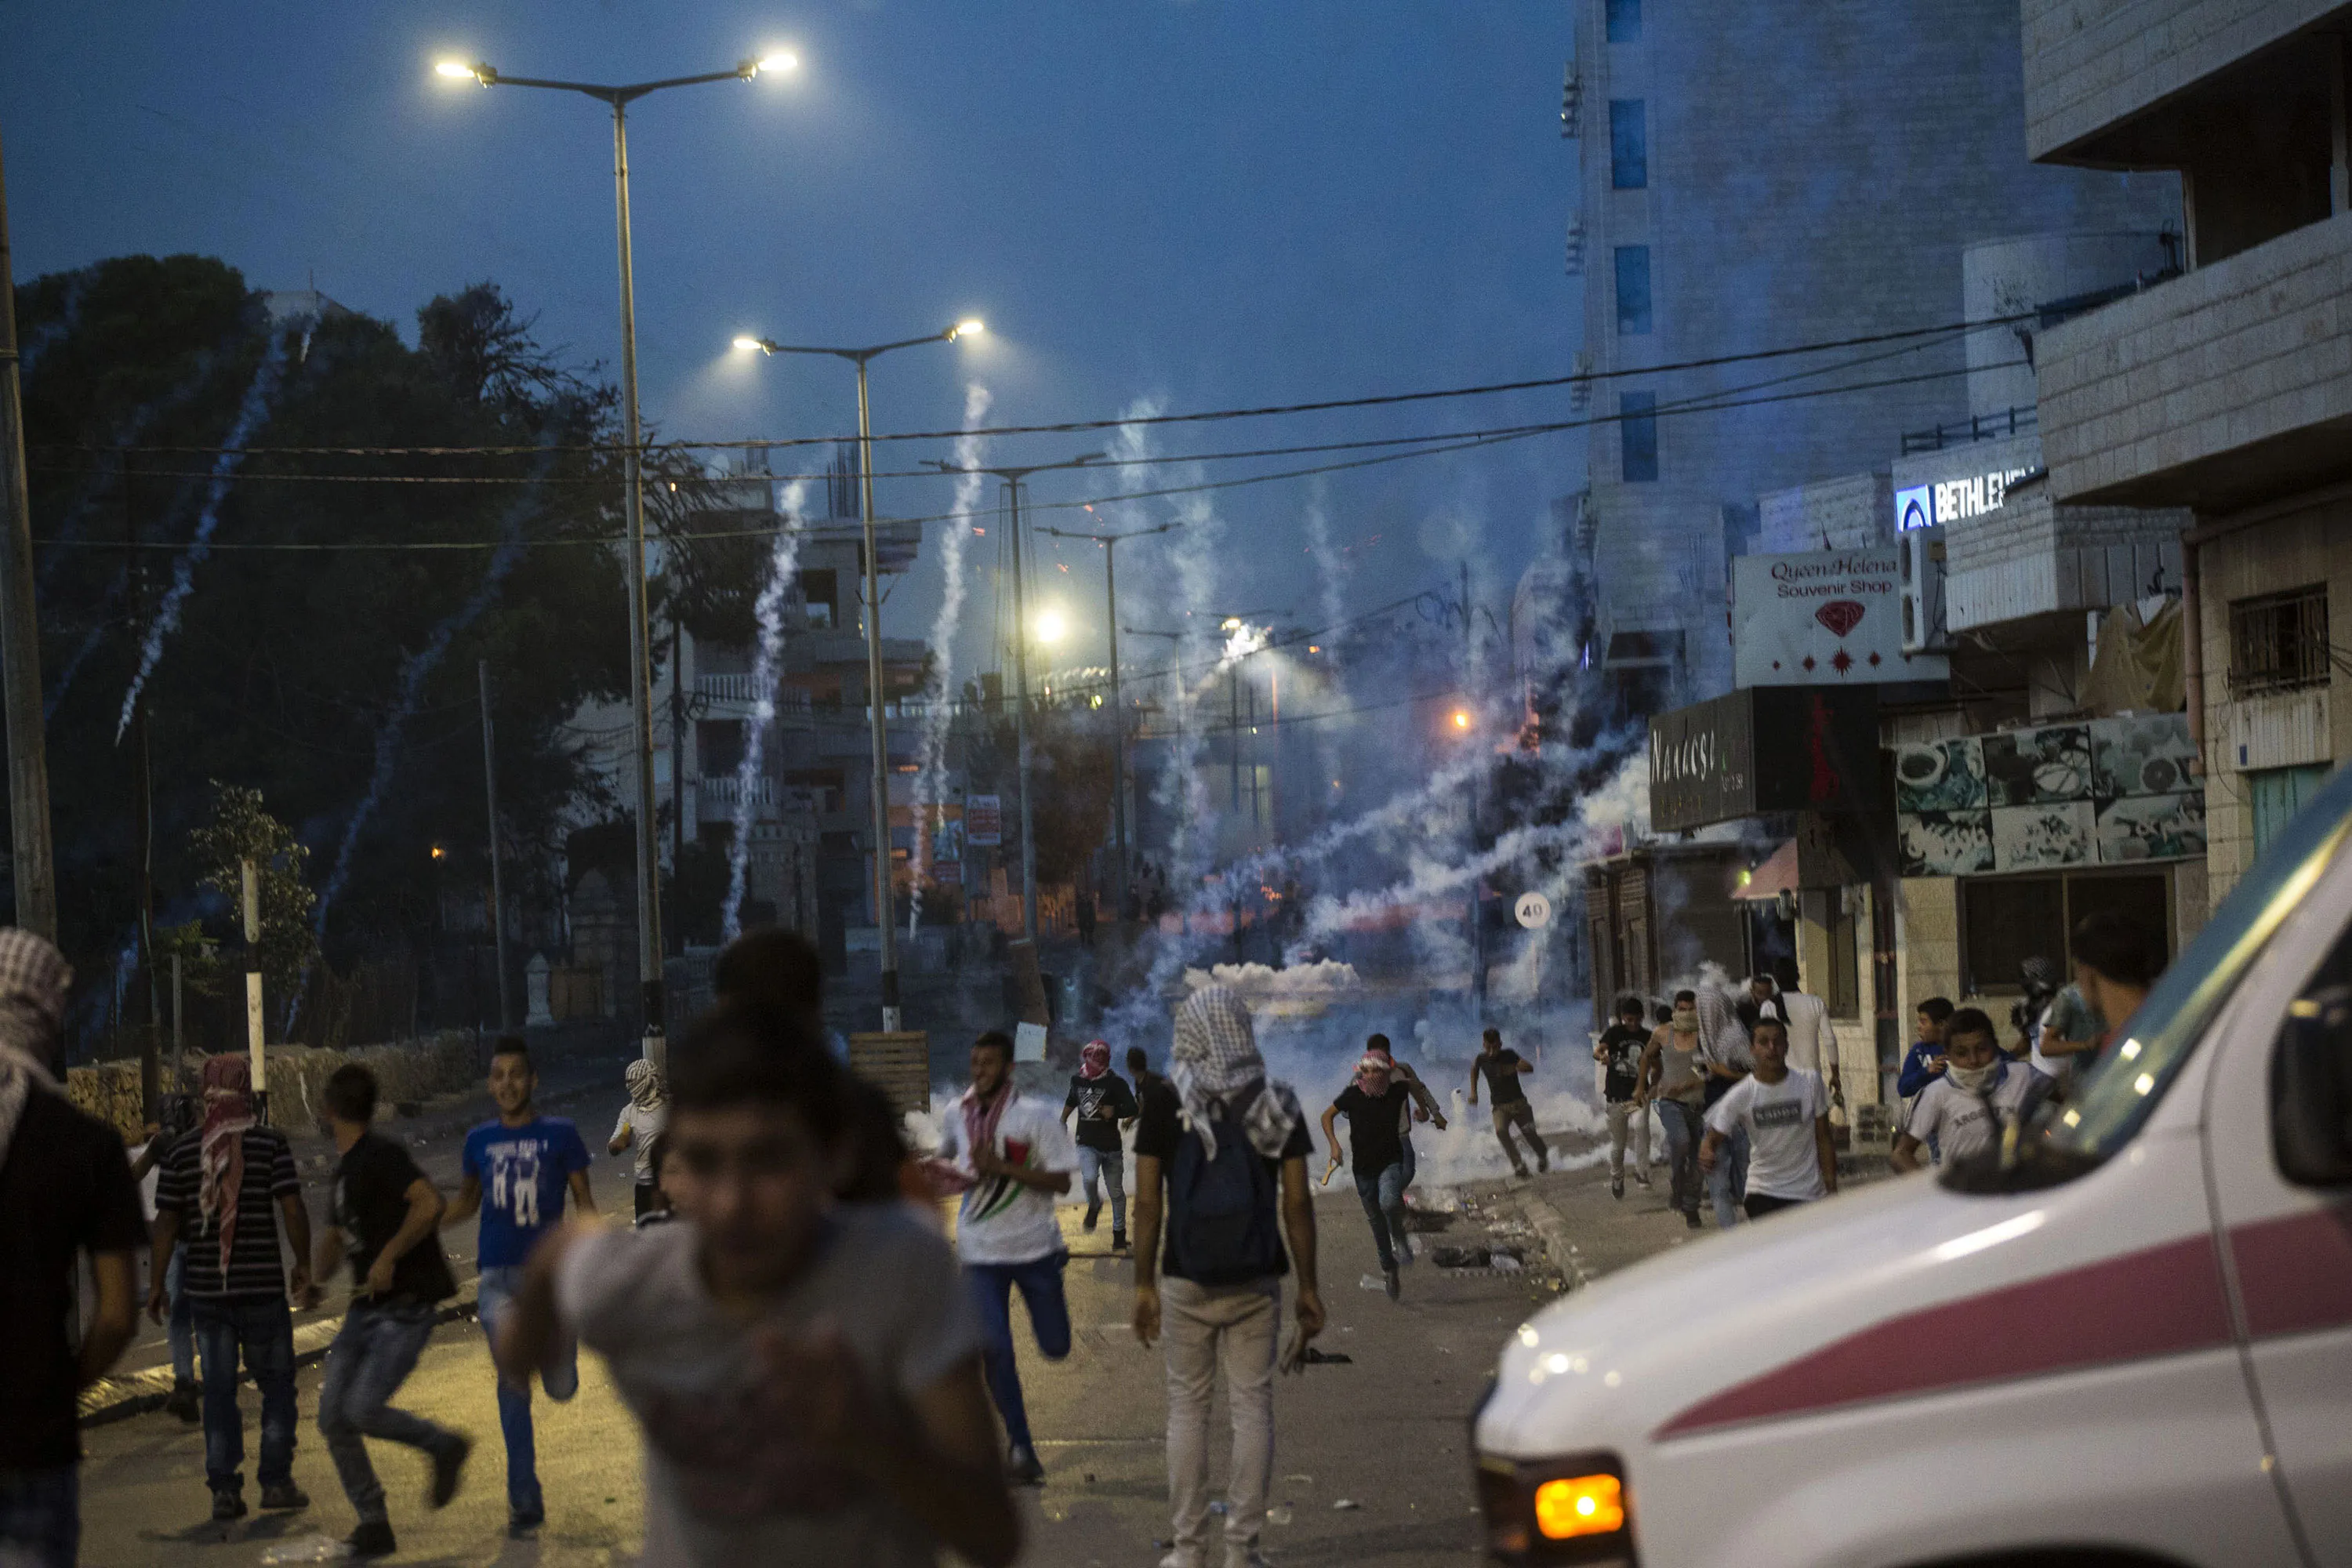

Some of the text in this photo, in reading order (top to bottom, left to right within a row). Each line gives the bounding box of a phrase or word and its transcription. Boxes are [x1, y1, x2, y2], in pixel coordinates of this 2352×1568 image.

[1935, 466, 2035, 523] BETHLEH
[1771, 555, 1897, 583] Queen Helena
[1777, 579, 1892, 598] Souvenir Shop
[1523, 903, 1543, 918] 40
